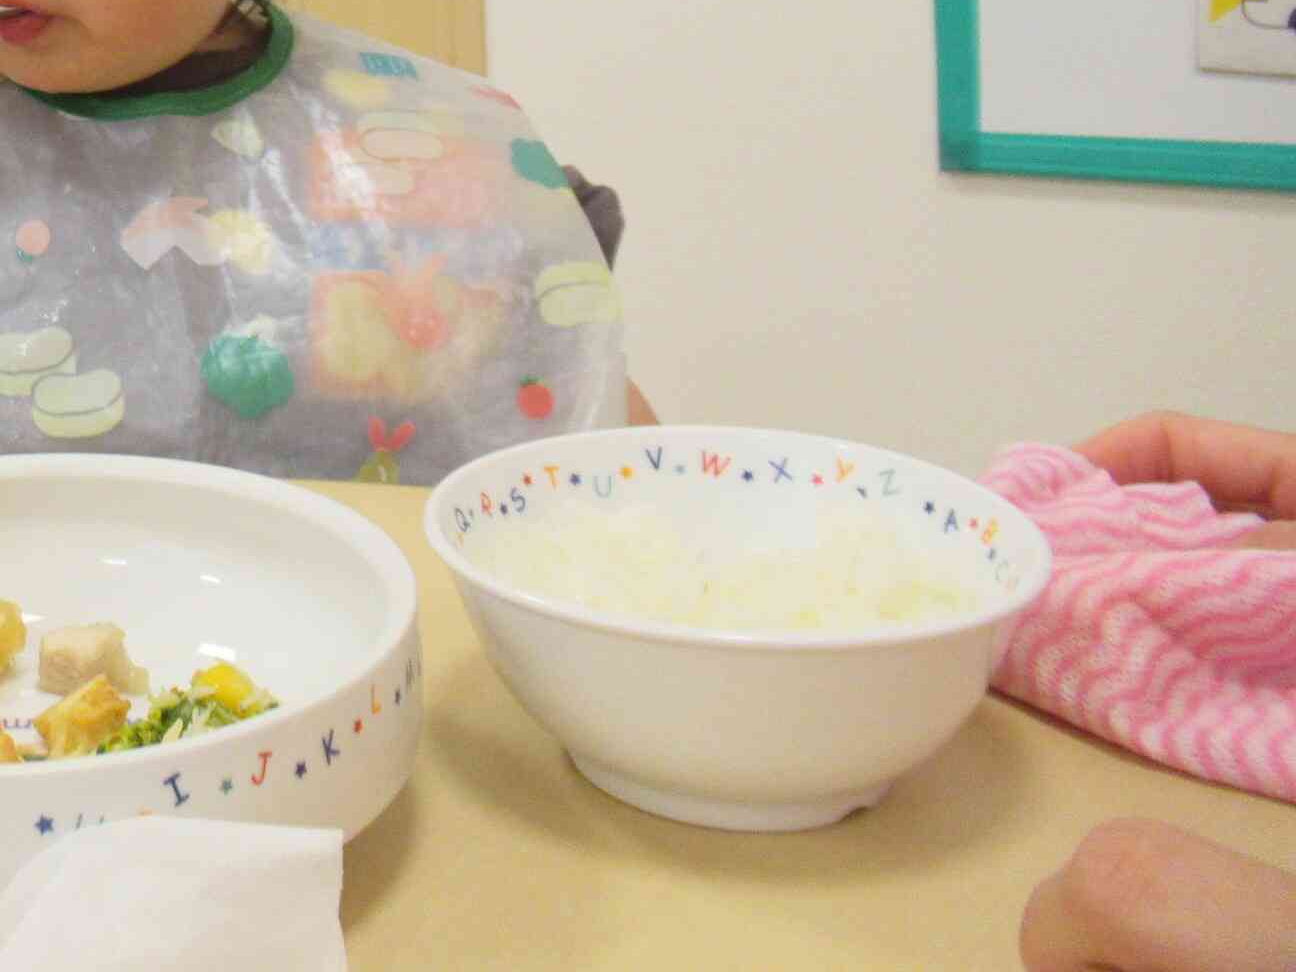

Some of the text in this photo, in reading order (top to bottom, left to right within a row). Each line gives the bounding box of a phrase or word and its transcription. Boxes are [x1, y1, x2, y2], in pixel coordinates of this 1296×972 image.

[510, 488, 526, 513] S
[544, 465, 559, 488] T
[593, 475, 612, 498] U
[645, 446, 662, 471] V
[701, 450, 731, 477] W
[768, 457, 792, 483] X
[836, 454, 855, 483] Y
[878, 468, 900, 496] Z
[944, 508, 959, 534] A
[163, 772, 190, 808] I
[251, 751, 272, 786] J
[321, 728, 340, 766] K
[370, 684, 382, 715] L
